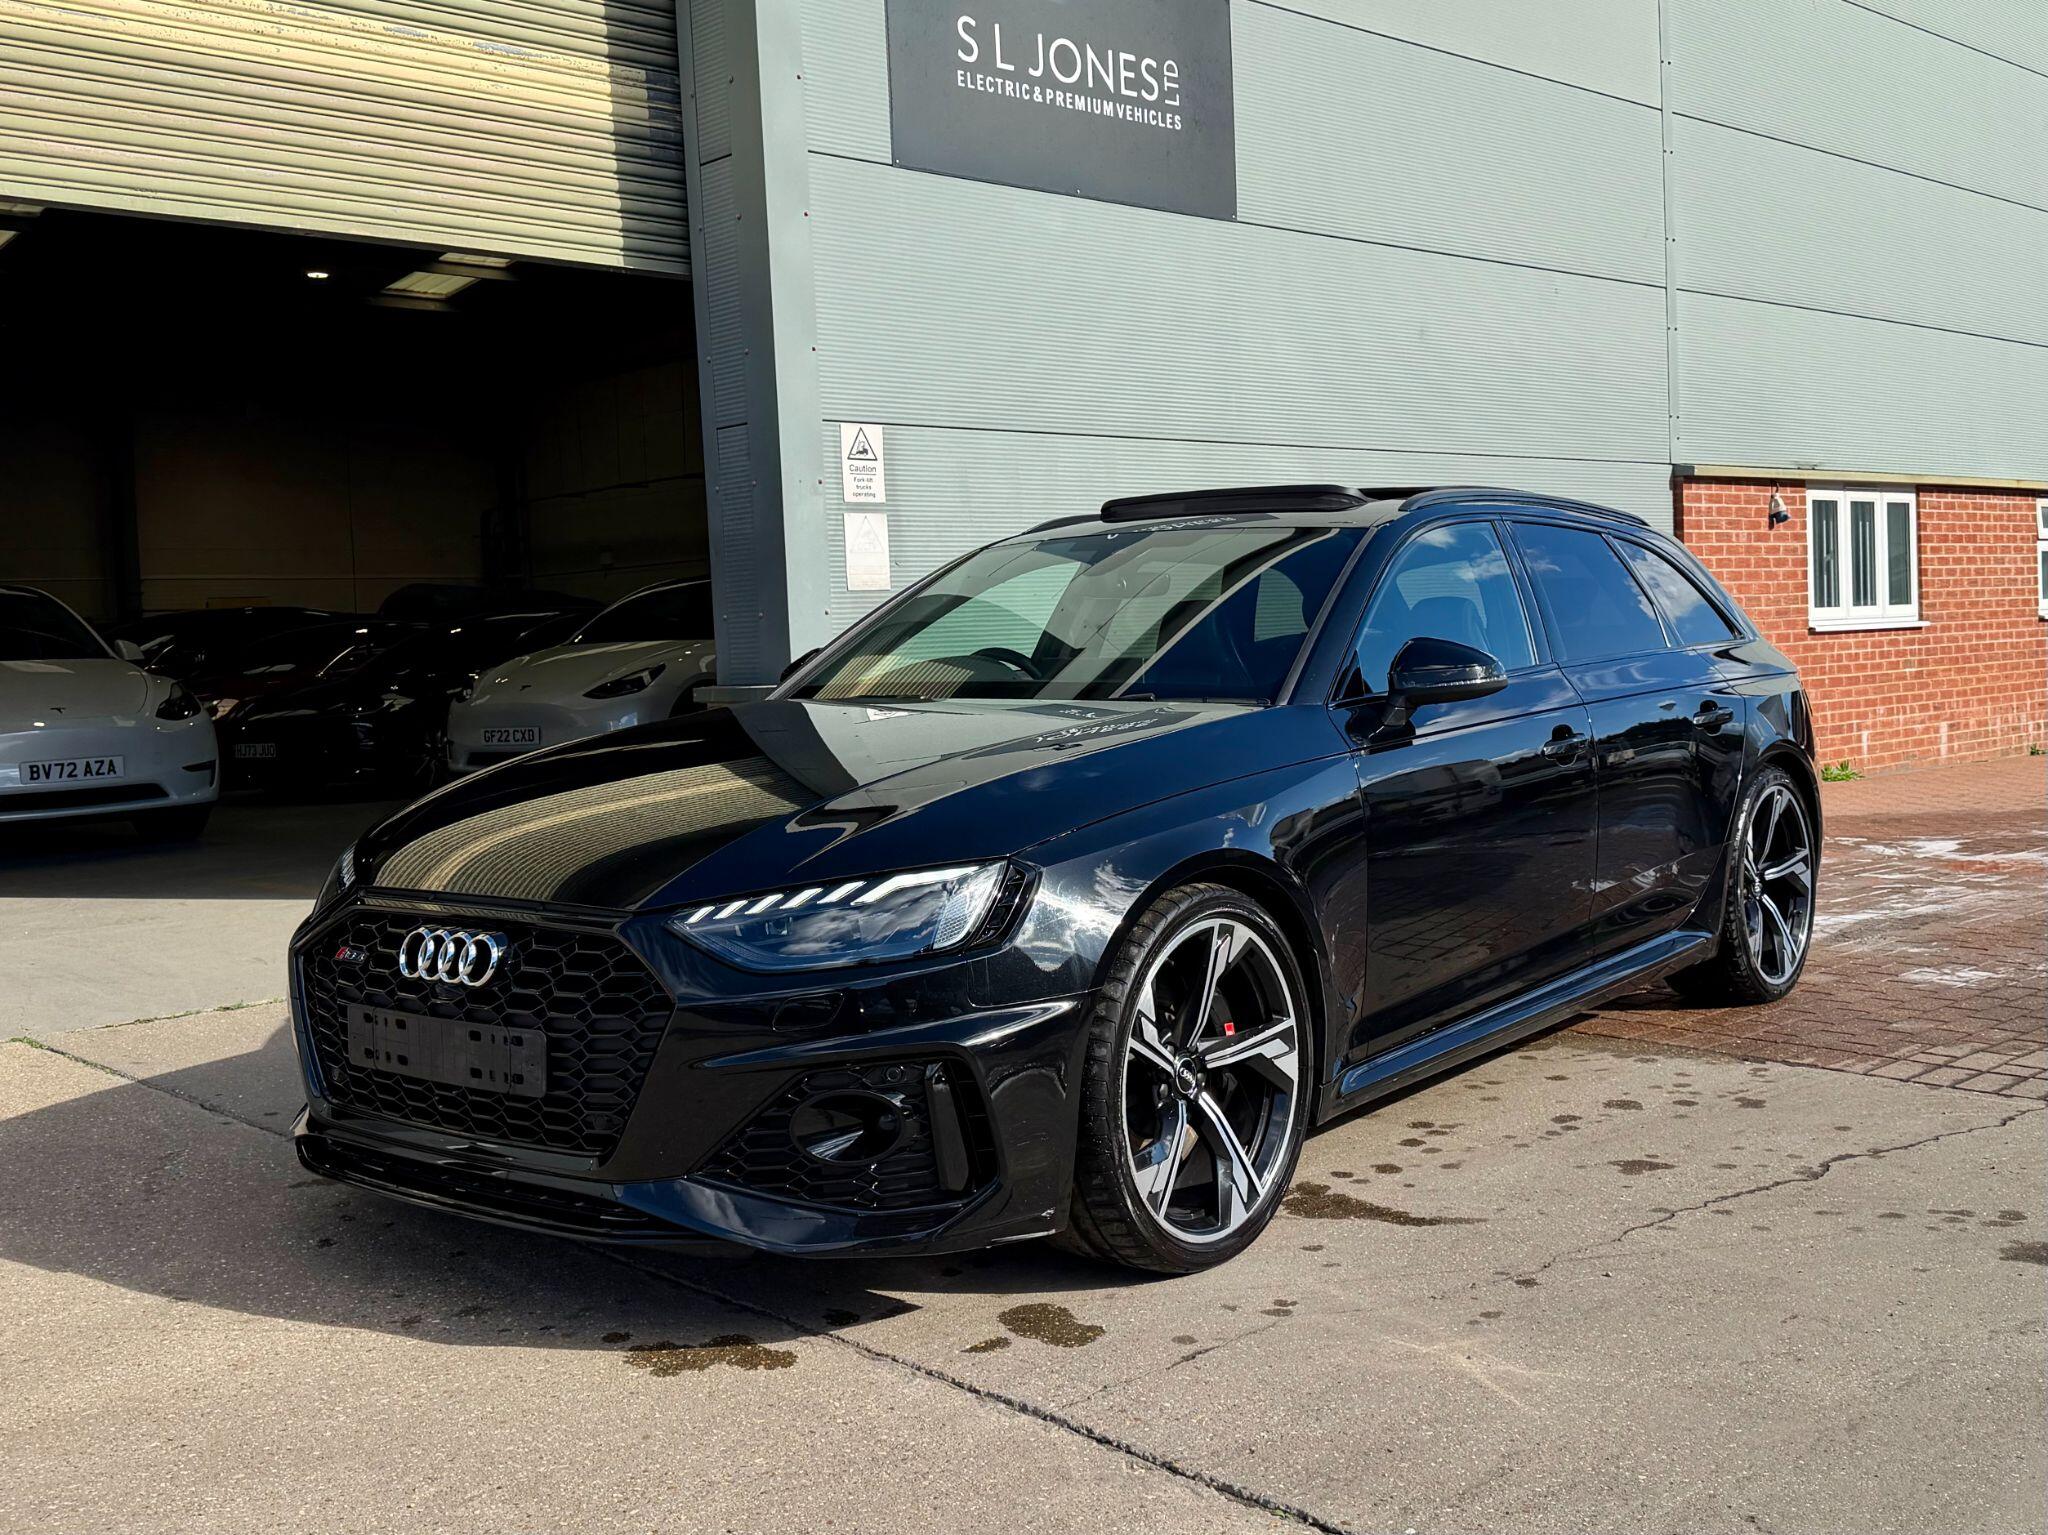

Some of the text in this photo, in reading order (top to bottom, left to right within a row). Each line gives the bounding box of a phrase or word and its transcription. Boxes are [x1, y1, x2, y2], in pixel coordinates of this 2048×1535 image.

[957, 15, 1159, 102] S L JONES
[957, 69, 1030, 100] ELECTRIC
[1046, 88, 1114, 117] PREMIUM
[1116, 103, 1181, 130] VEHICLES
[1163, 59, 1180, 107] LTD
[849, 464, 877, 473] Caution
[484, 729, 510, 743] GF22
[28, 758, 117, 781] BV72 AZA
